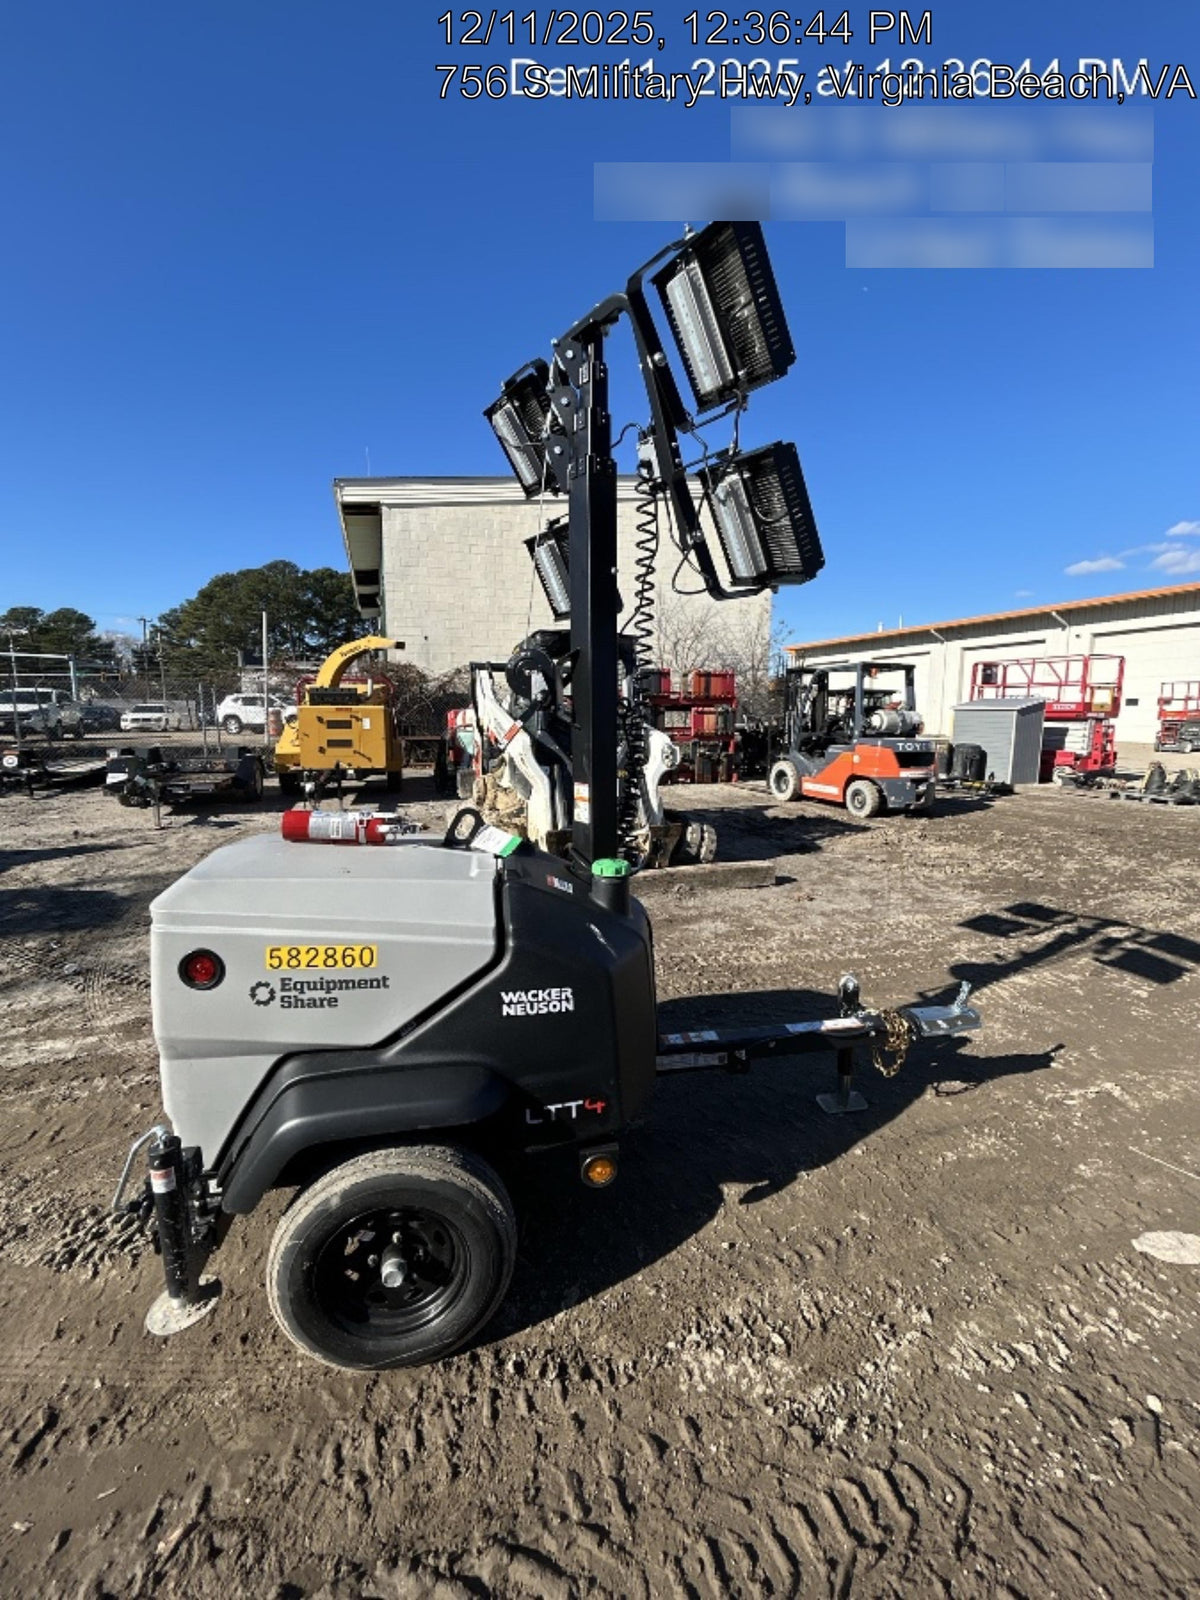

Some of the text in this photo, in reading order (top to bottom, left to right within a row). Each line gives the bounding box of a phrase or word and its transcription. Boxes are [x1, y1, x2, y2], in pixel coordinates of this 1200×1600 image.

[268, 946, 374, 970] 582860
[280, 976, 390, 994] Equipment
[280, 994, 338, 1009] Share
[500, 987, 574, 1004] WACKER
[502, 998, 574, 1016] NEUSON
[525, 1098, 606, 1124] LTT4
